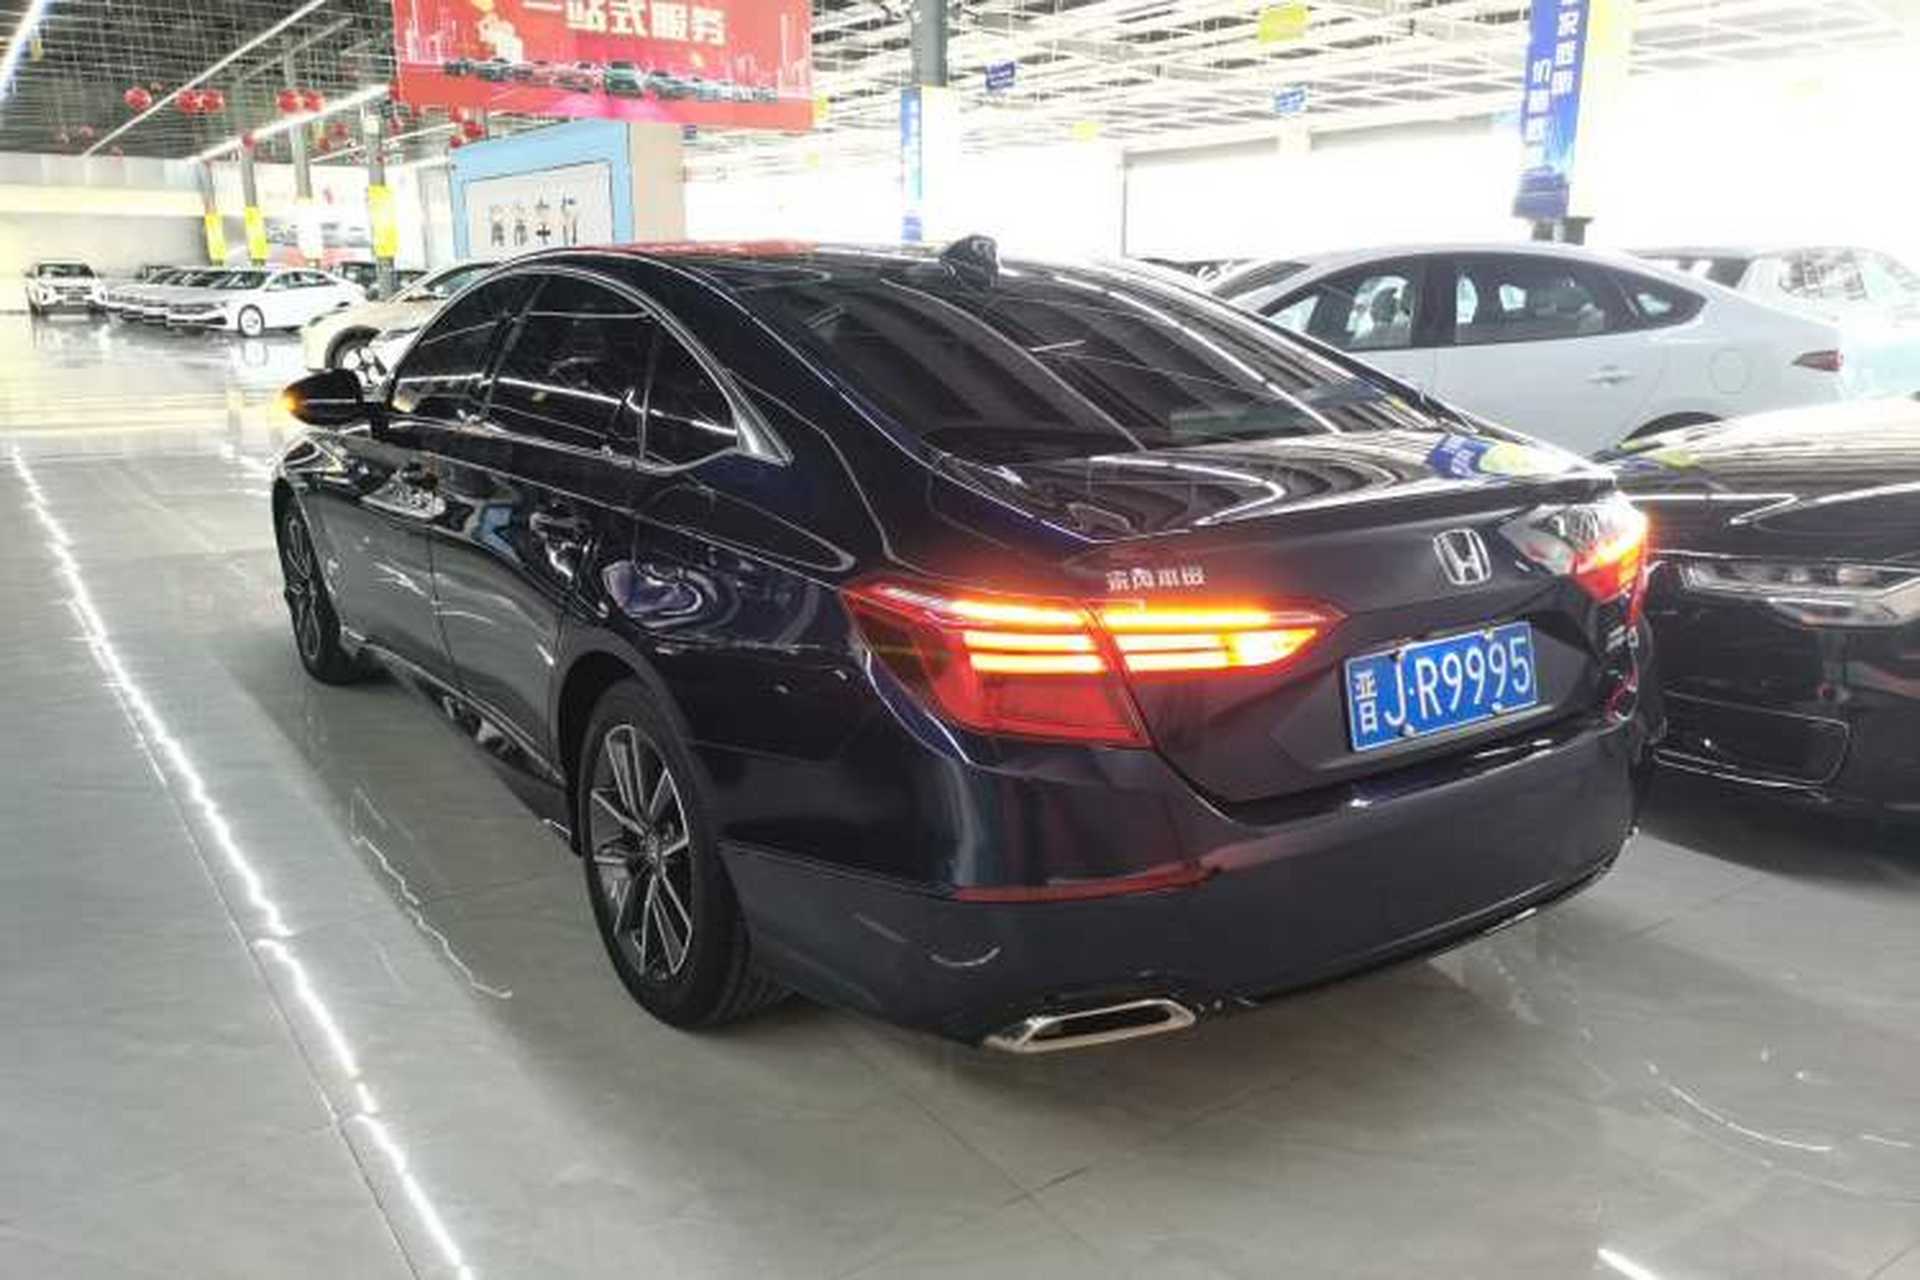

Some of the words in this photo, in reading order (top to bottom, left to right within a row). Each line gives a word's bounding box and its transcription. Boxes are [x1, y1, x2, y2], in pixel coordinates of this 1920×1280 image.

[521, 0, 726, 46] 一站式服务
